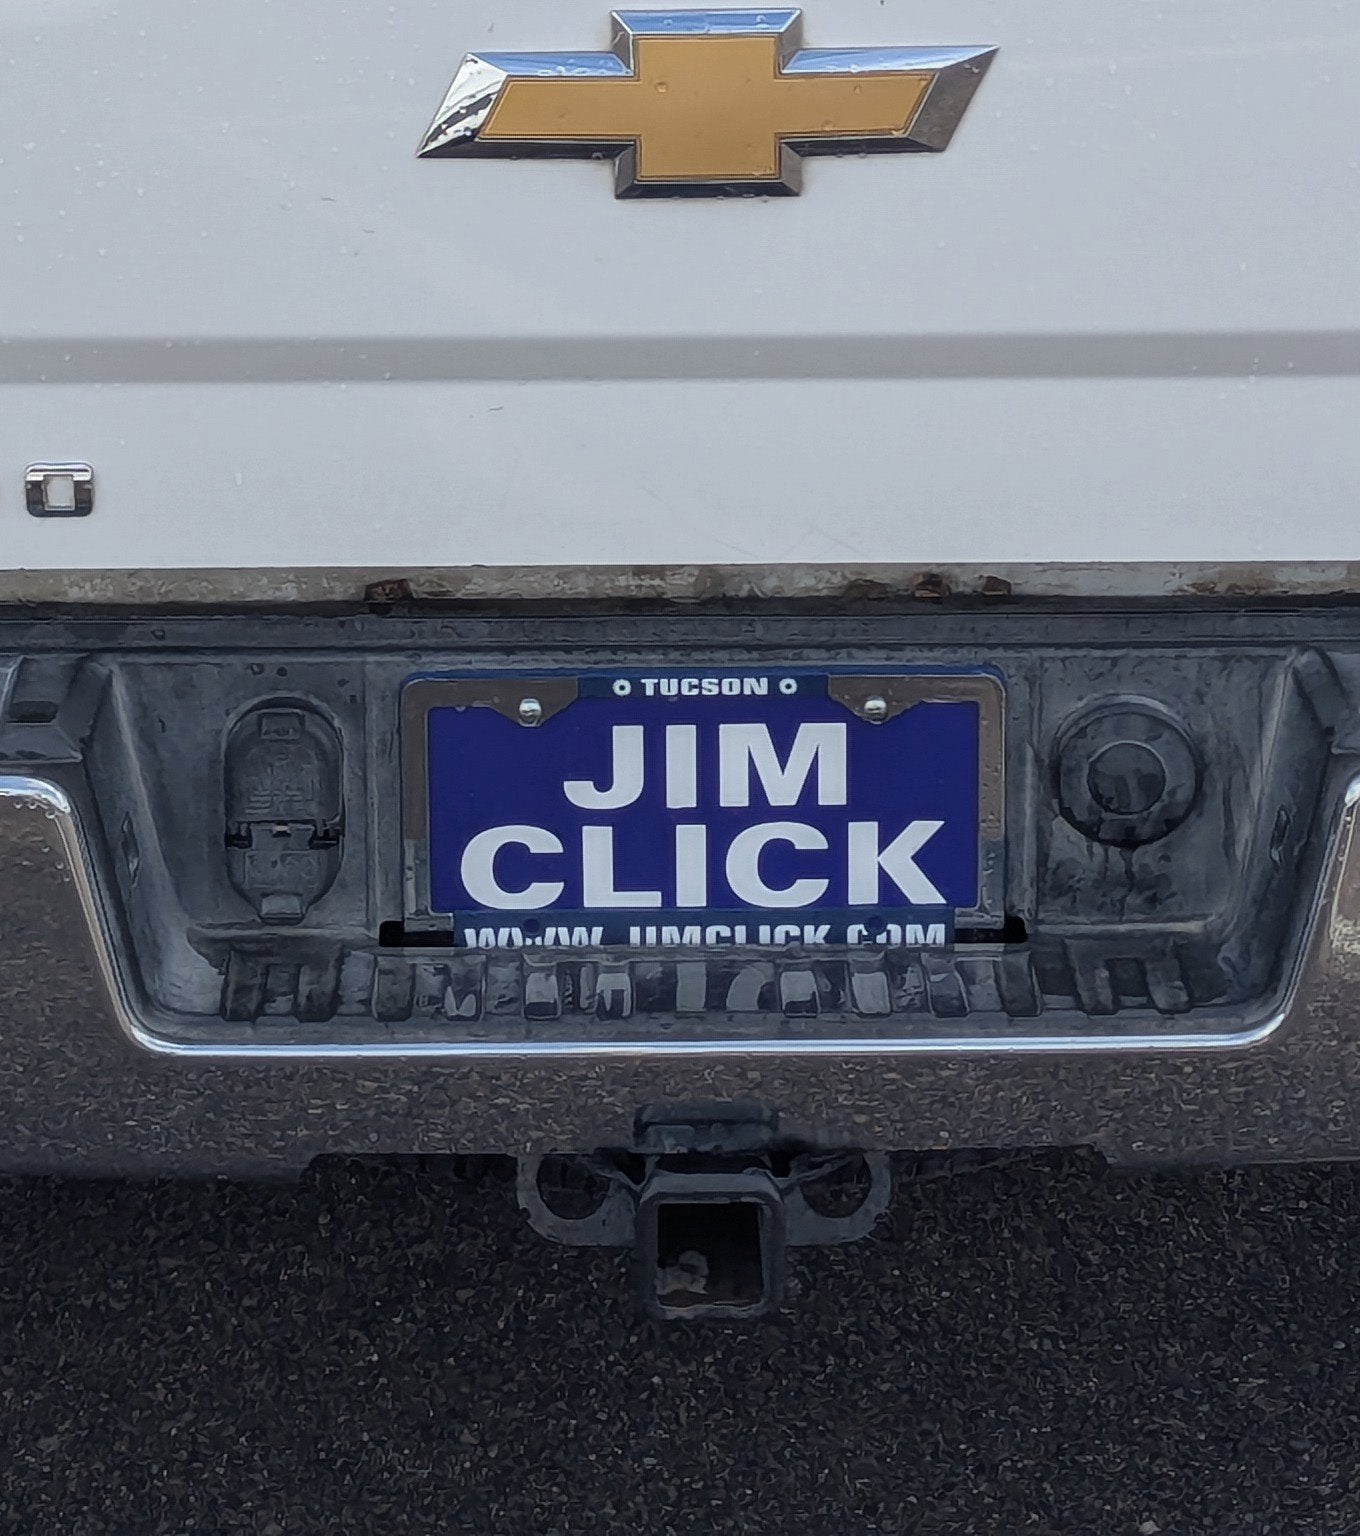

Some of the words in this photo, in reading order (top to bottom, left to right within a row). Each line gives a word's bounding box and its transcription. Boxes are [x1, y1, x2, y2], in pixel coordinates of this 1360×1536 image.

[640, 677, 768, 696] TUCSON
[563, 722, 847, 810] JIM
[460, 820, 947, 910] CLICK
